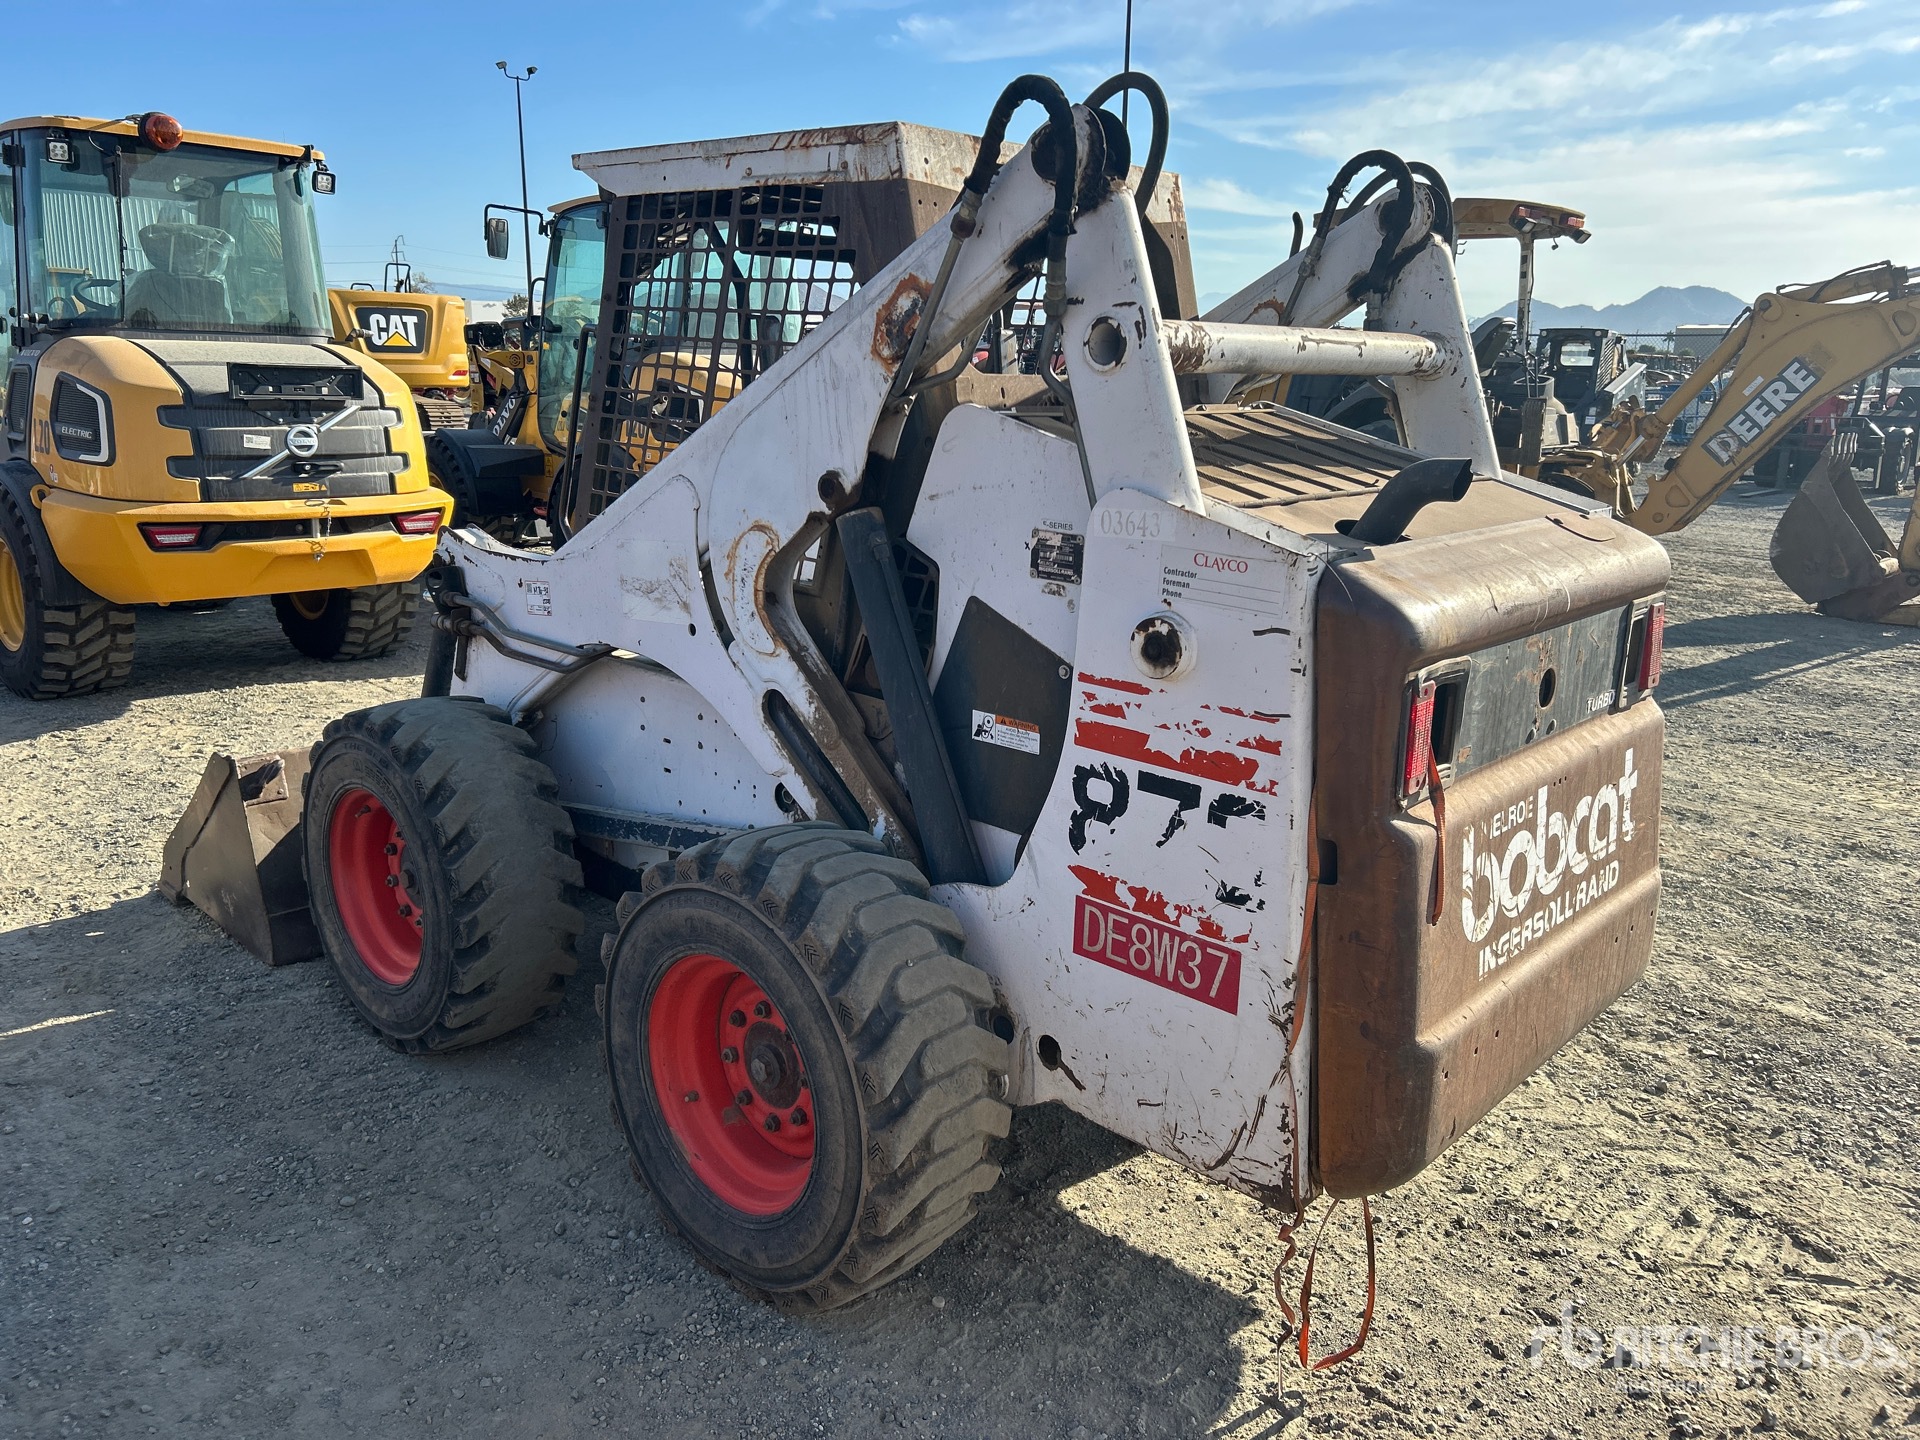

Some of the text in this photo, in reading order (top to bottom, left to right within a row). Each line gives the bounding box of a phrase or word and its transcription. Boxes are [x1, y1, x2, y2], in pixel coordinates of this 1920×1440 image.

[369, 313, 419, 347] CAT
[492, 396, 517, 438] OLVO
[1706, 361, 1816, 463] DEERE
[34, 418, 50, 455] L20
[61, 425, 93, 439] ELECTRIC
[1100, 509, 1161, 538] 03643
[1163, 566, 1198, 579] Contractor
[1193, 552, 1248, 574] CLAYCO
[1161, 587, 1183, 599] Phone
[1162, 577, 1190, 589] Foreman
[1586, 690, 1616, 714] TURBO
[1009, 719, 1036, 731] WARNING
[1461, 748, 1638, 943] bobcat
[1082, 904, 1230, 999] DE8W37
